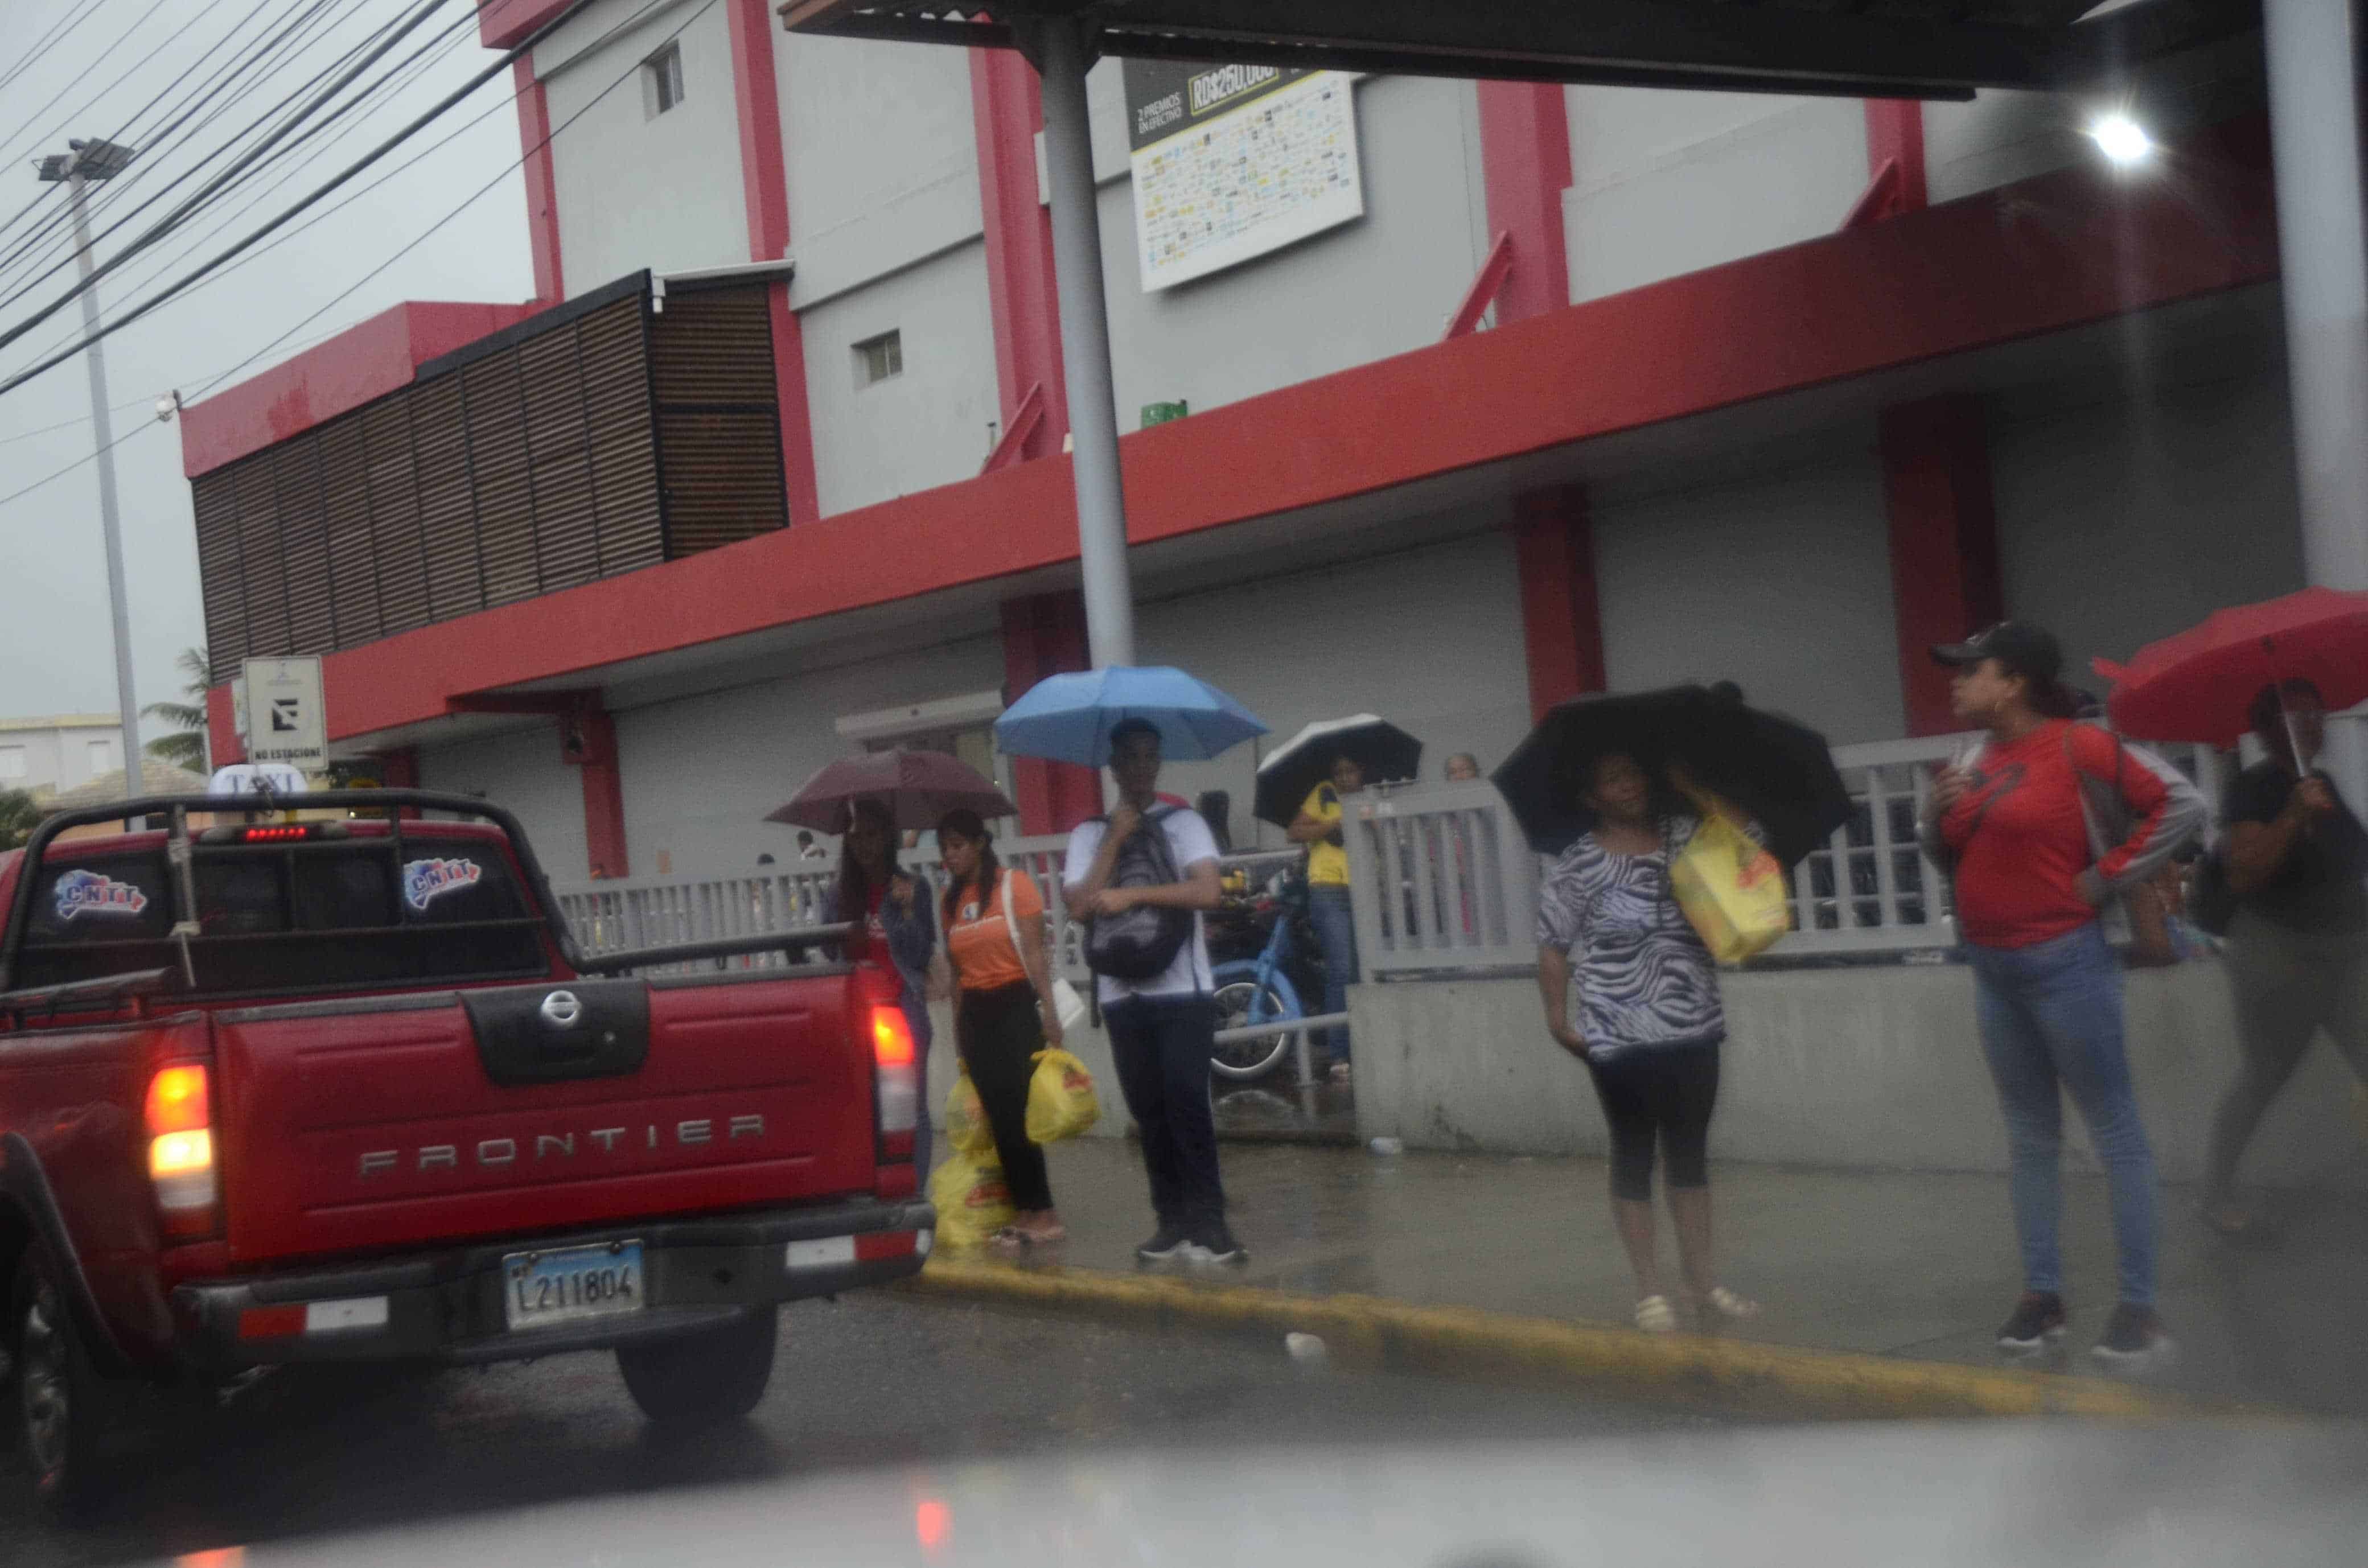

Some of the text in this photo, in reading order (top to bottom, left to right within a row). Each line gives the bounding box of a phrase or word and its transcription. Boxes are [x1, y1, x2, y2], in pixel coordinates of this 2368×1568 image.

[1144, 91, 1181, 118] PREMIOS
[255, 747, 321, 760] NO ESTACIONE
[412, 859, 468, 892] CNTT
[66, 886, 137, 902] CNTT
[360, 1114, 763, 1178] FRONTIER
[517, 1264, 632, 1312] L211804
